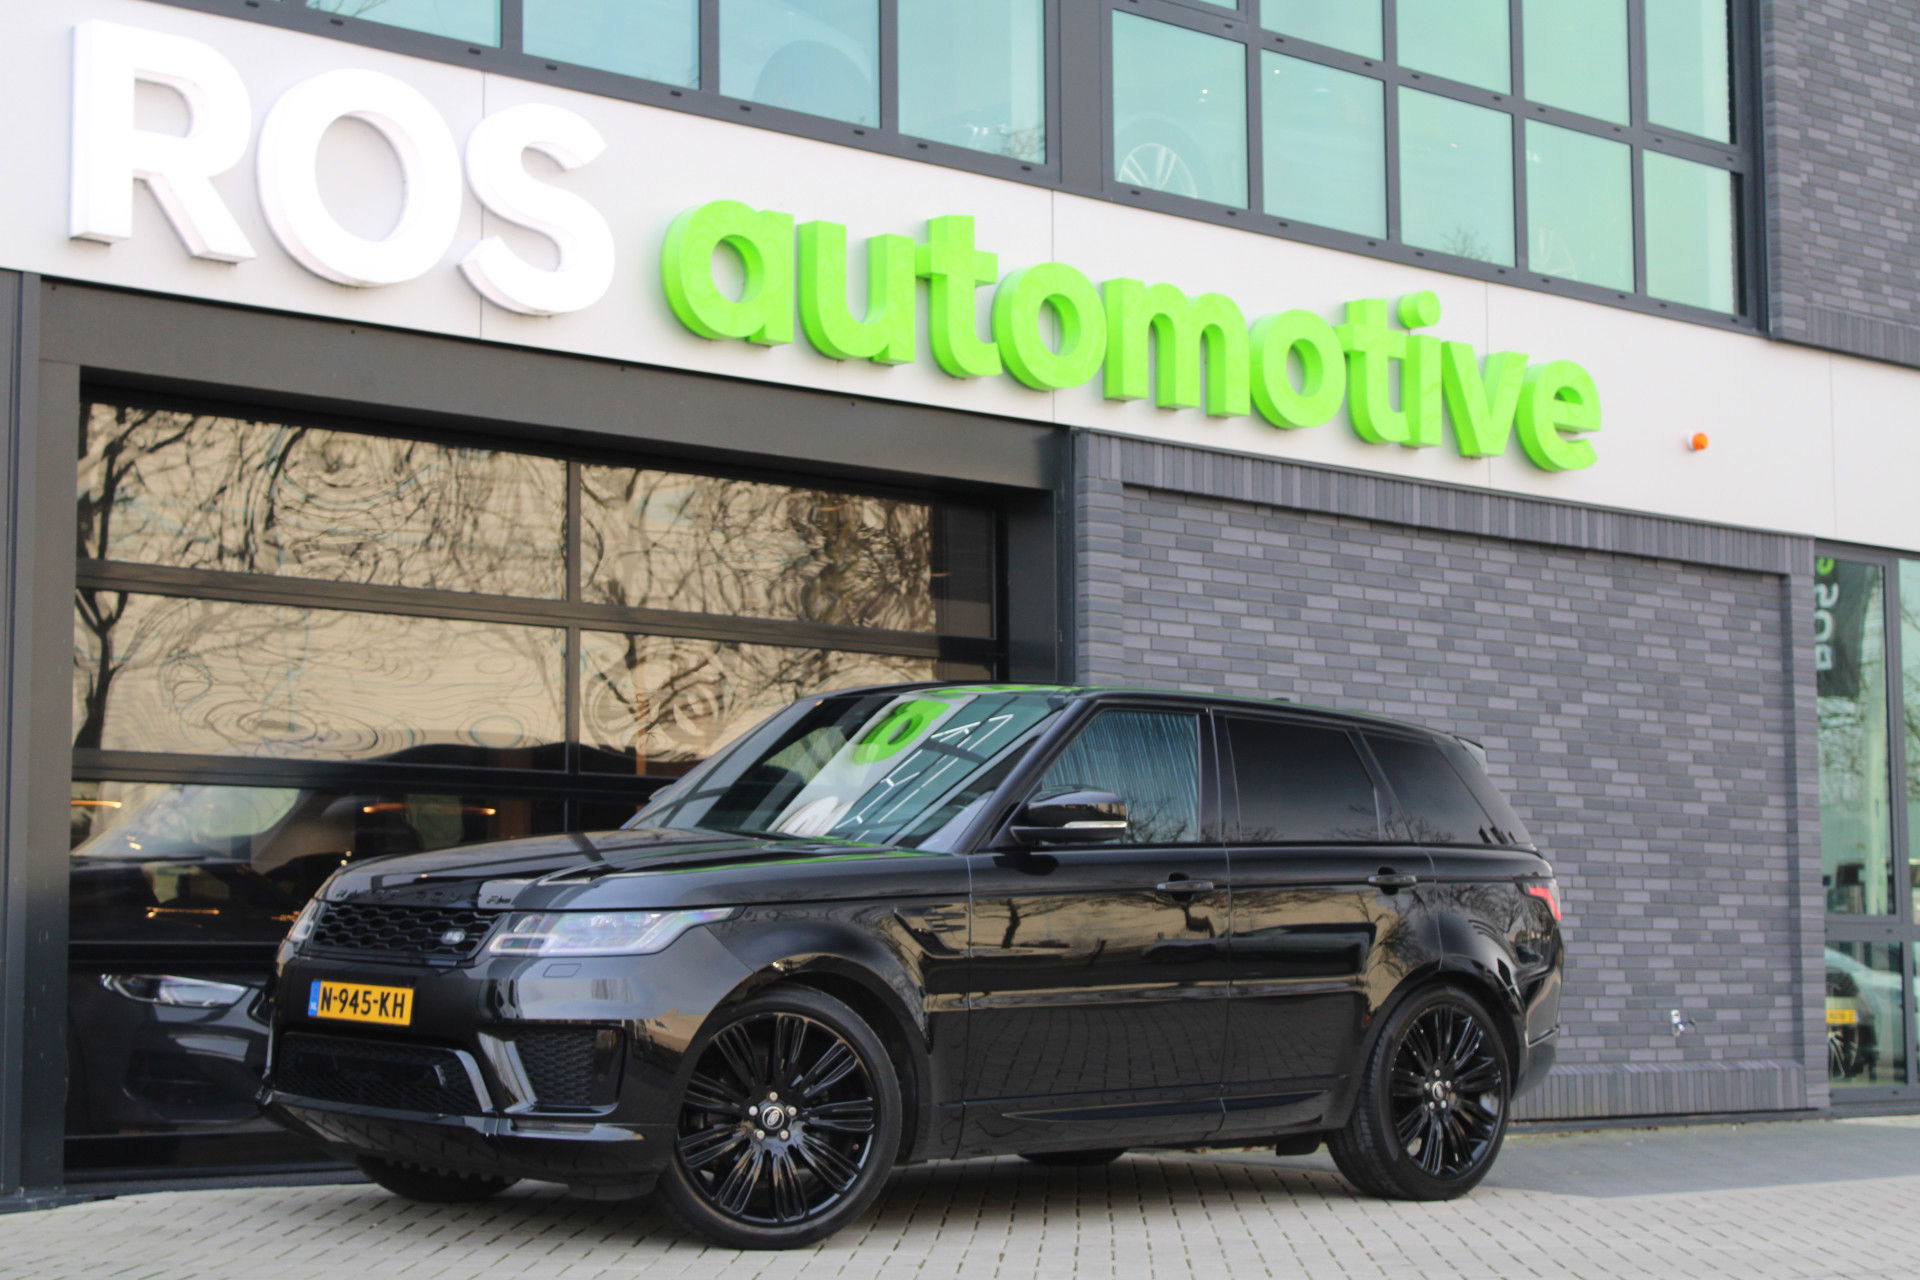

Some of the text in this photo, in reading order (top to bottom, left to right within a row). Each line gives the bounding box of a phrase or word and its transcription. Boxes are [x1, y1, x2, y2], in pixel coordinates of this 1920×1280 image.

[69, 19, 1600, 472] ROS automotive
[320, 986, 405, 1018] N-945-KH
